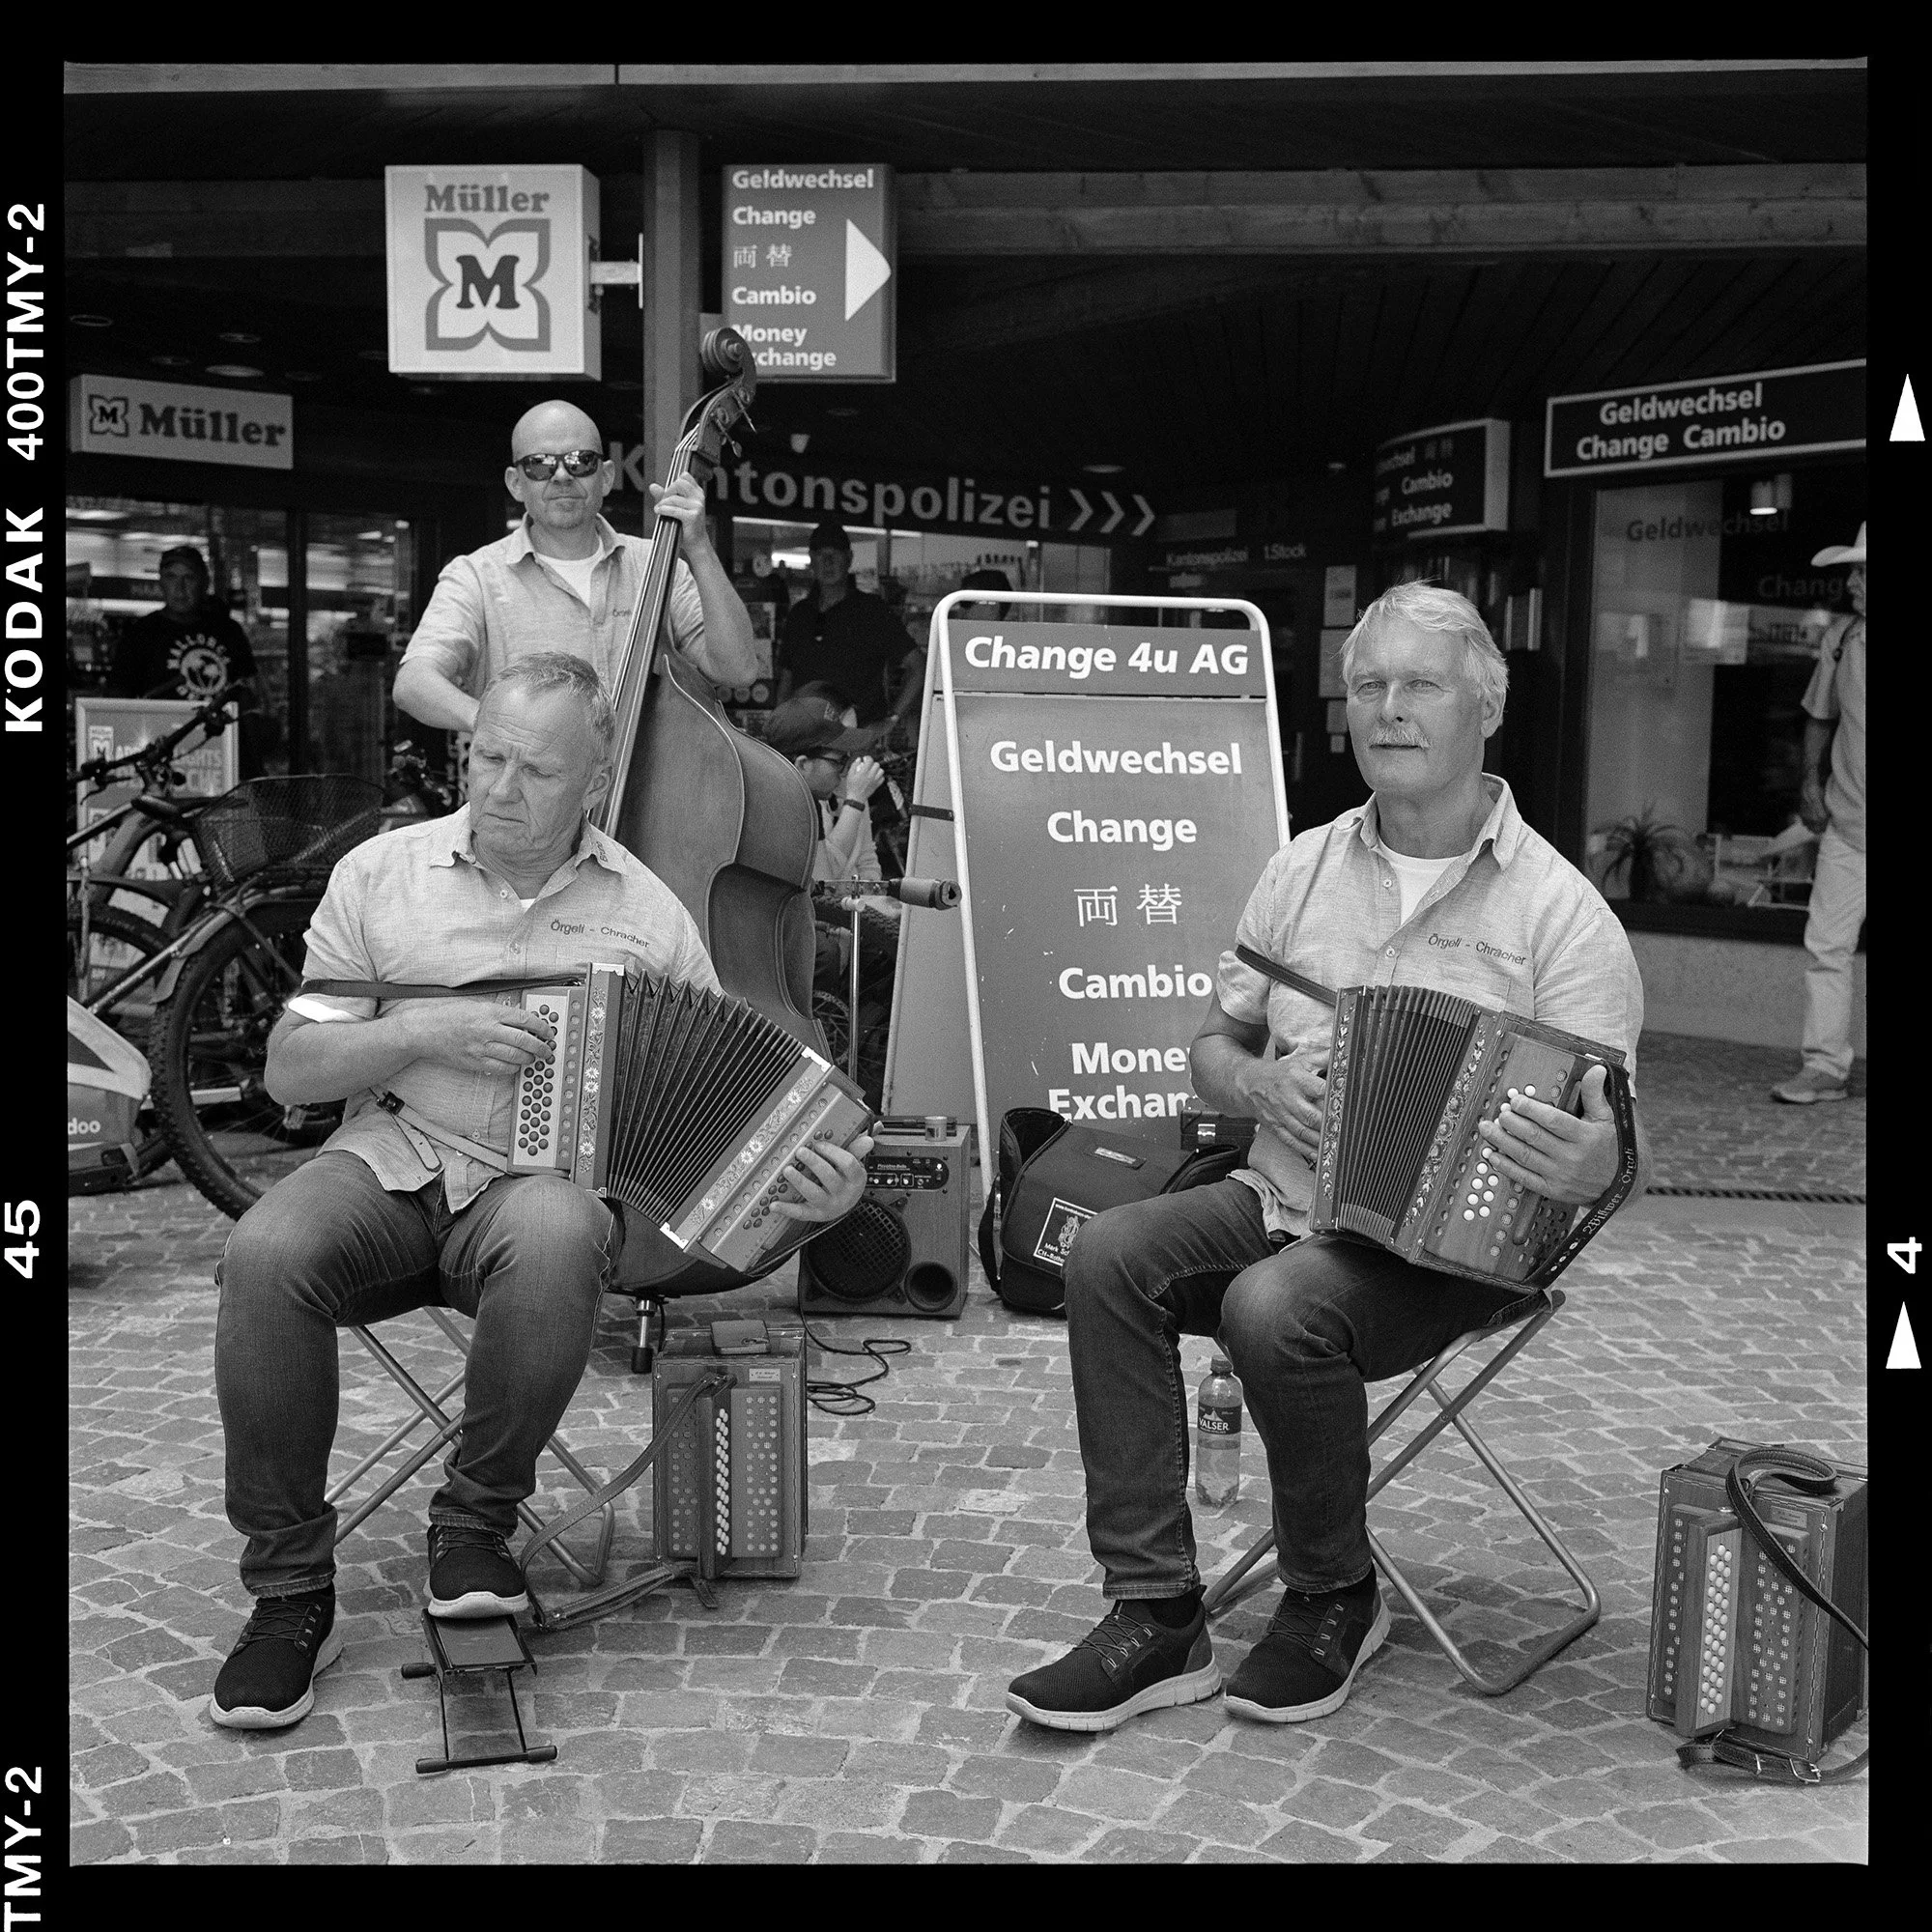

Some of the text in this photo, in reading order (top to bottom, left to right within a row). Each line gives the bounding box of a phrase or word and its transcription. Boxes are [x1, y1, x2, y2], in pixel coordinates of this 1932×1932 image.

[731, 168, 874, 189] Geldwechsel
[424, 184, 551, 213] Müller
[731, 206, 816, 230] Change
[456, 254, 521, 309] M
[731, 285, 817, 305] Cambio
[731, 324, 808, 347] Money
[751, 347, 838, 372] change
[1599, 382, 1763, 426] Geldwechsel
[138, 403, 287, 447] Müller
[1575, 415, 1787, 462] Change Cambio
[4, 203, 44, 732] KODAK 400TMY-2
[611, 440, 1051, 530] Kntonspolizei
[1626, 515, 1789, 543] Geldwechsel
[1758, 574, 1846, 604] Chang
[965, 636, 1249, 680] Change 4u AG
[989, 740, 1242, 775] Geldwechsel
[1046, 810, 1198, 852] Change
[1073, 883, 1182, 927] 両替
[551, 919, 584, 935] Örgeli
[600, 926, 650, 948] Chracher
[1428, 932, 1463, 949] Örgeli
[1475, 941, 1526, 965] Chracher
[1059, 964, 1213, 999] Cambio
[1071, 1041, 1191, 1074] Mone
[1048, 1084, 1191, 1121] Exchan
[3, 1199, 41, 1279] 45
[1887, 1236, 1923, 1275] 4
[1198, 1417, 1231, 1431] VALSER
